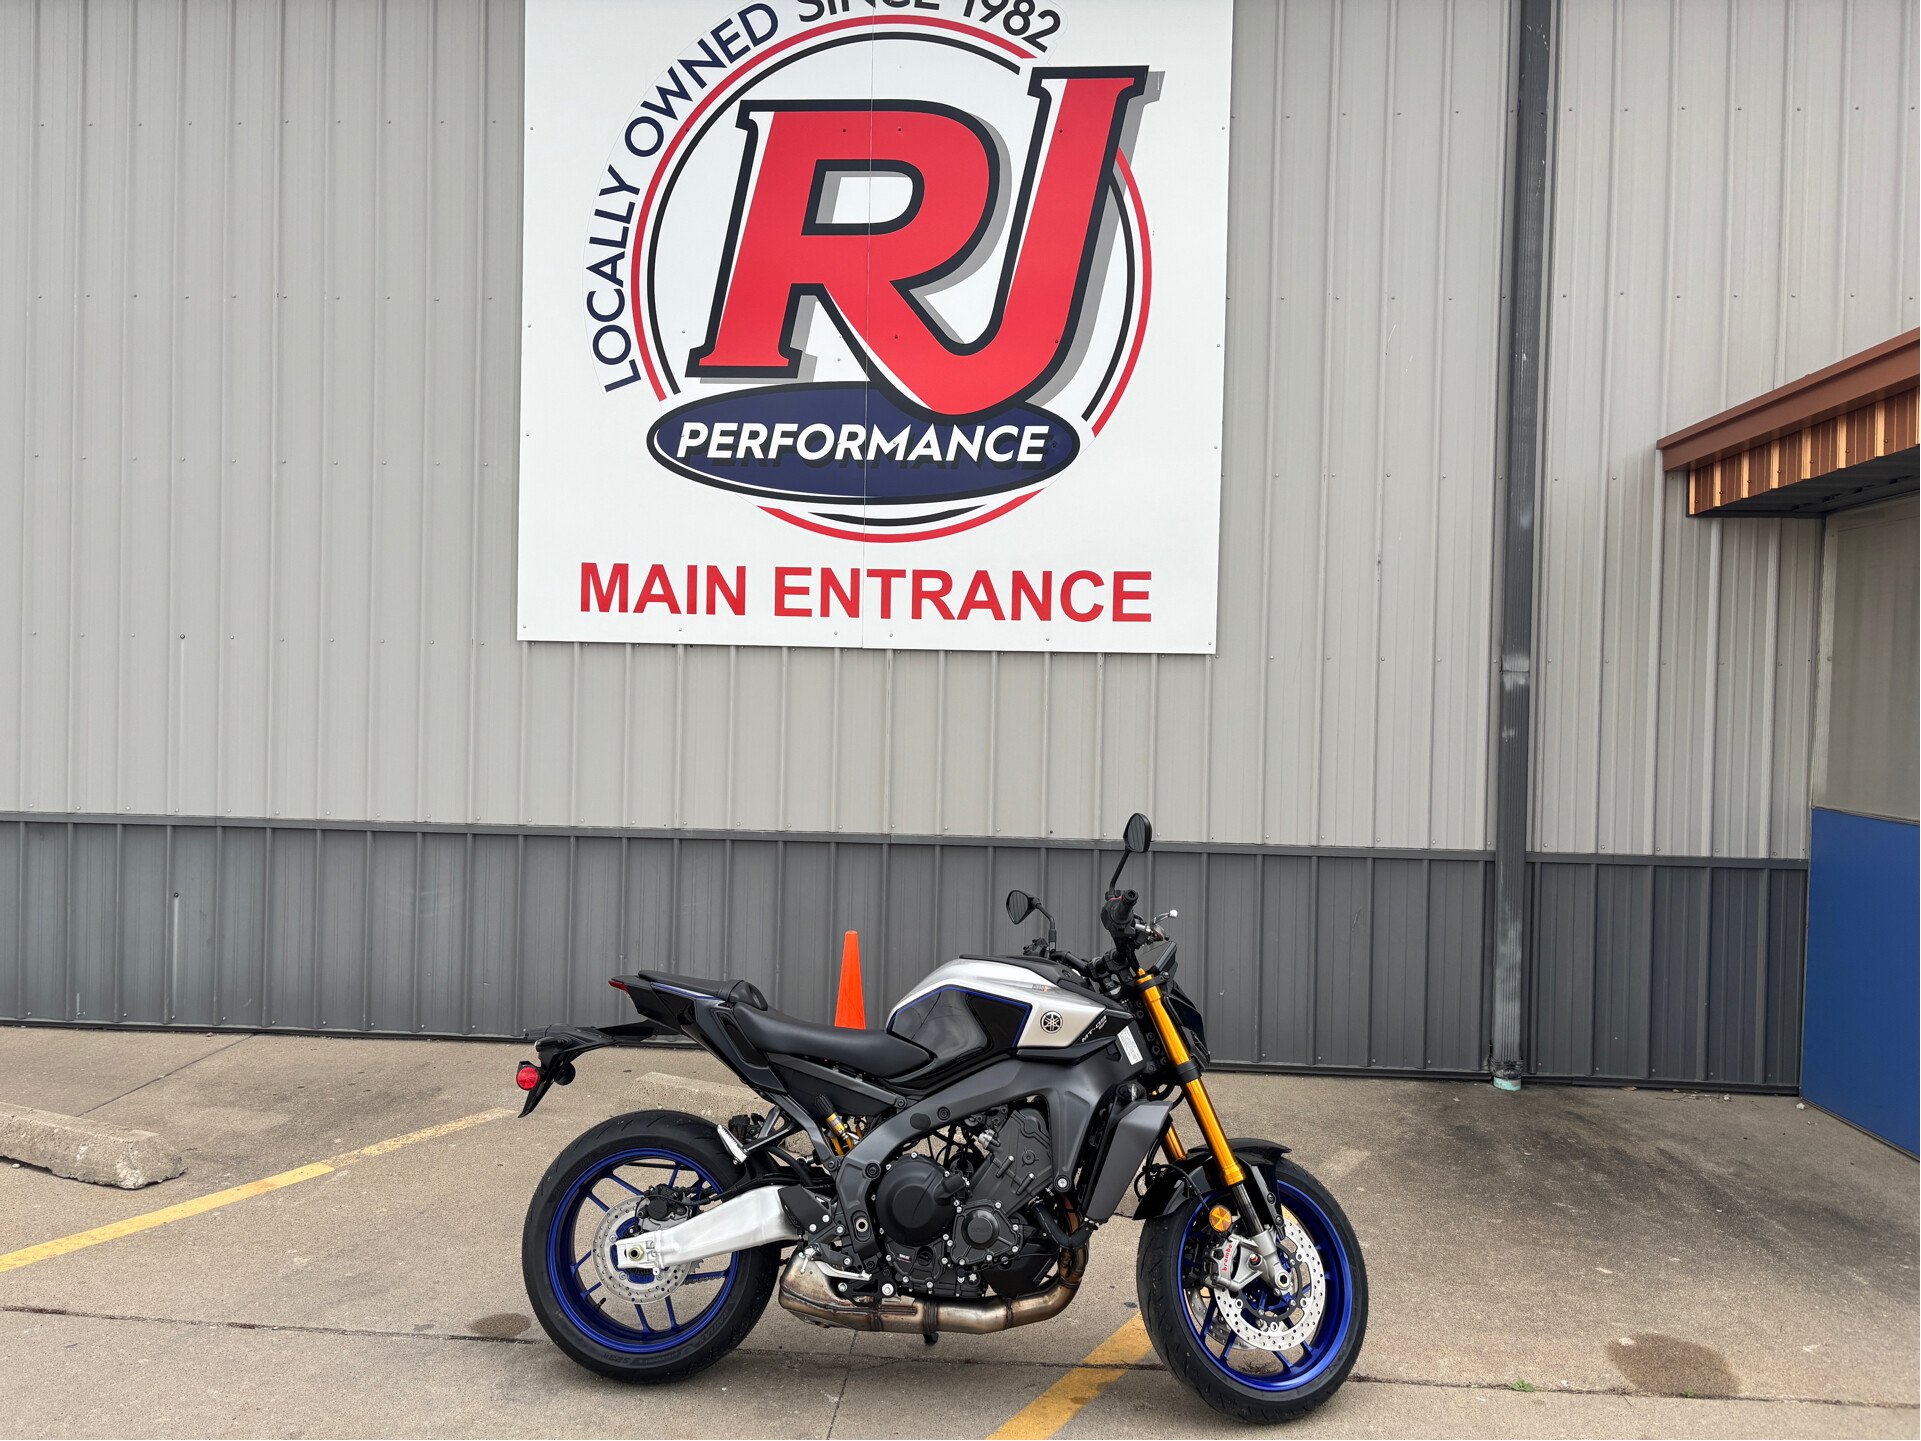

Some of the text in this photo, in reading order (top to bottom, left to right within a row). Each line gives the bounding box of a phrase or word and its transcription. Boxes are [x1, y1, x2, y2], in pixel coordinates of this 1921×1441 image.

[586, 164, 641, 392] LOCALLY
[624, 3, 778, 157] OWNED
[685, 65, 1150, 427] RJ
[677, 422, 1049, 463] PERFORMANCE
[580, 562, 1152, 622] MAIN ENTRANCE
[1221, 1244, 1233, 1271] brembo
